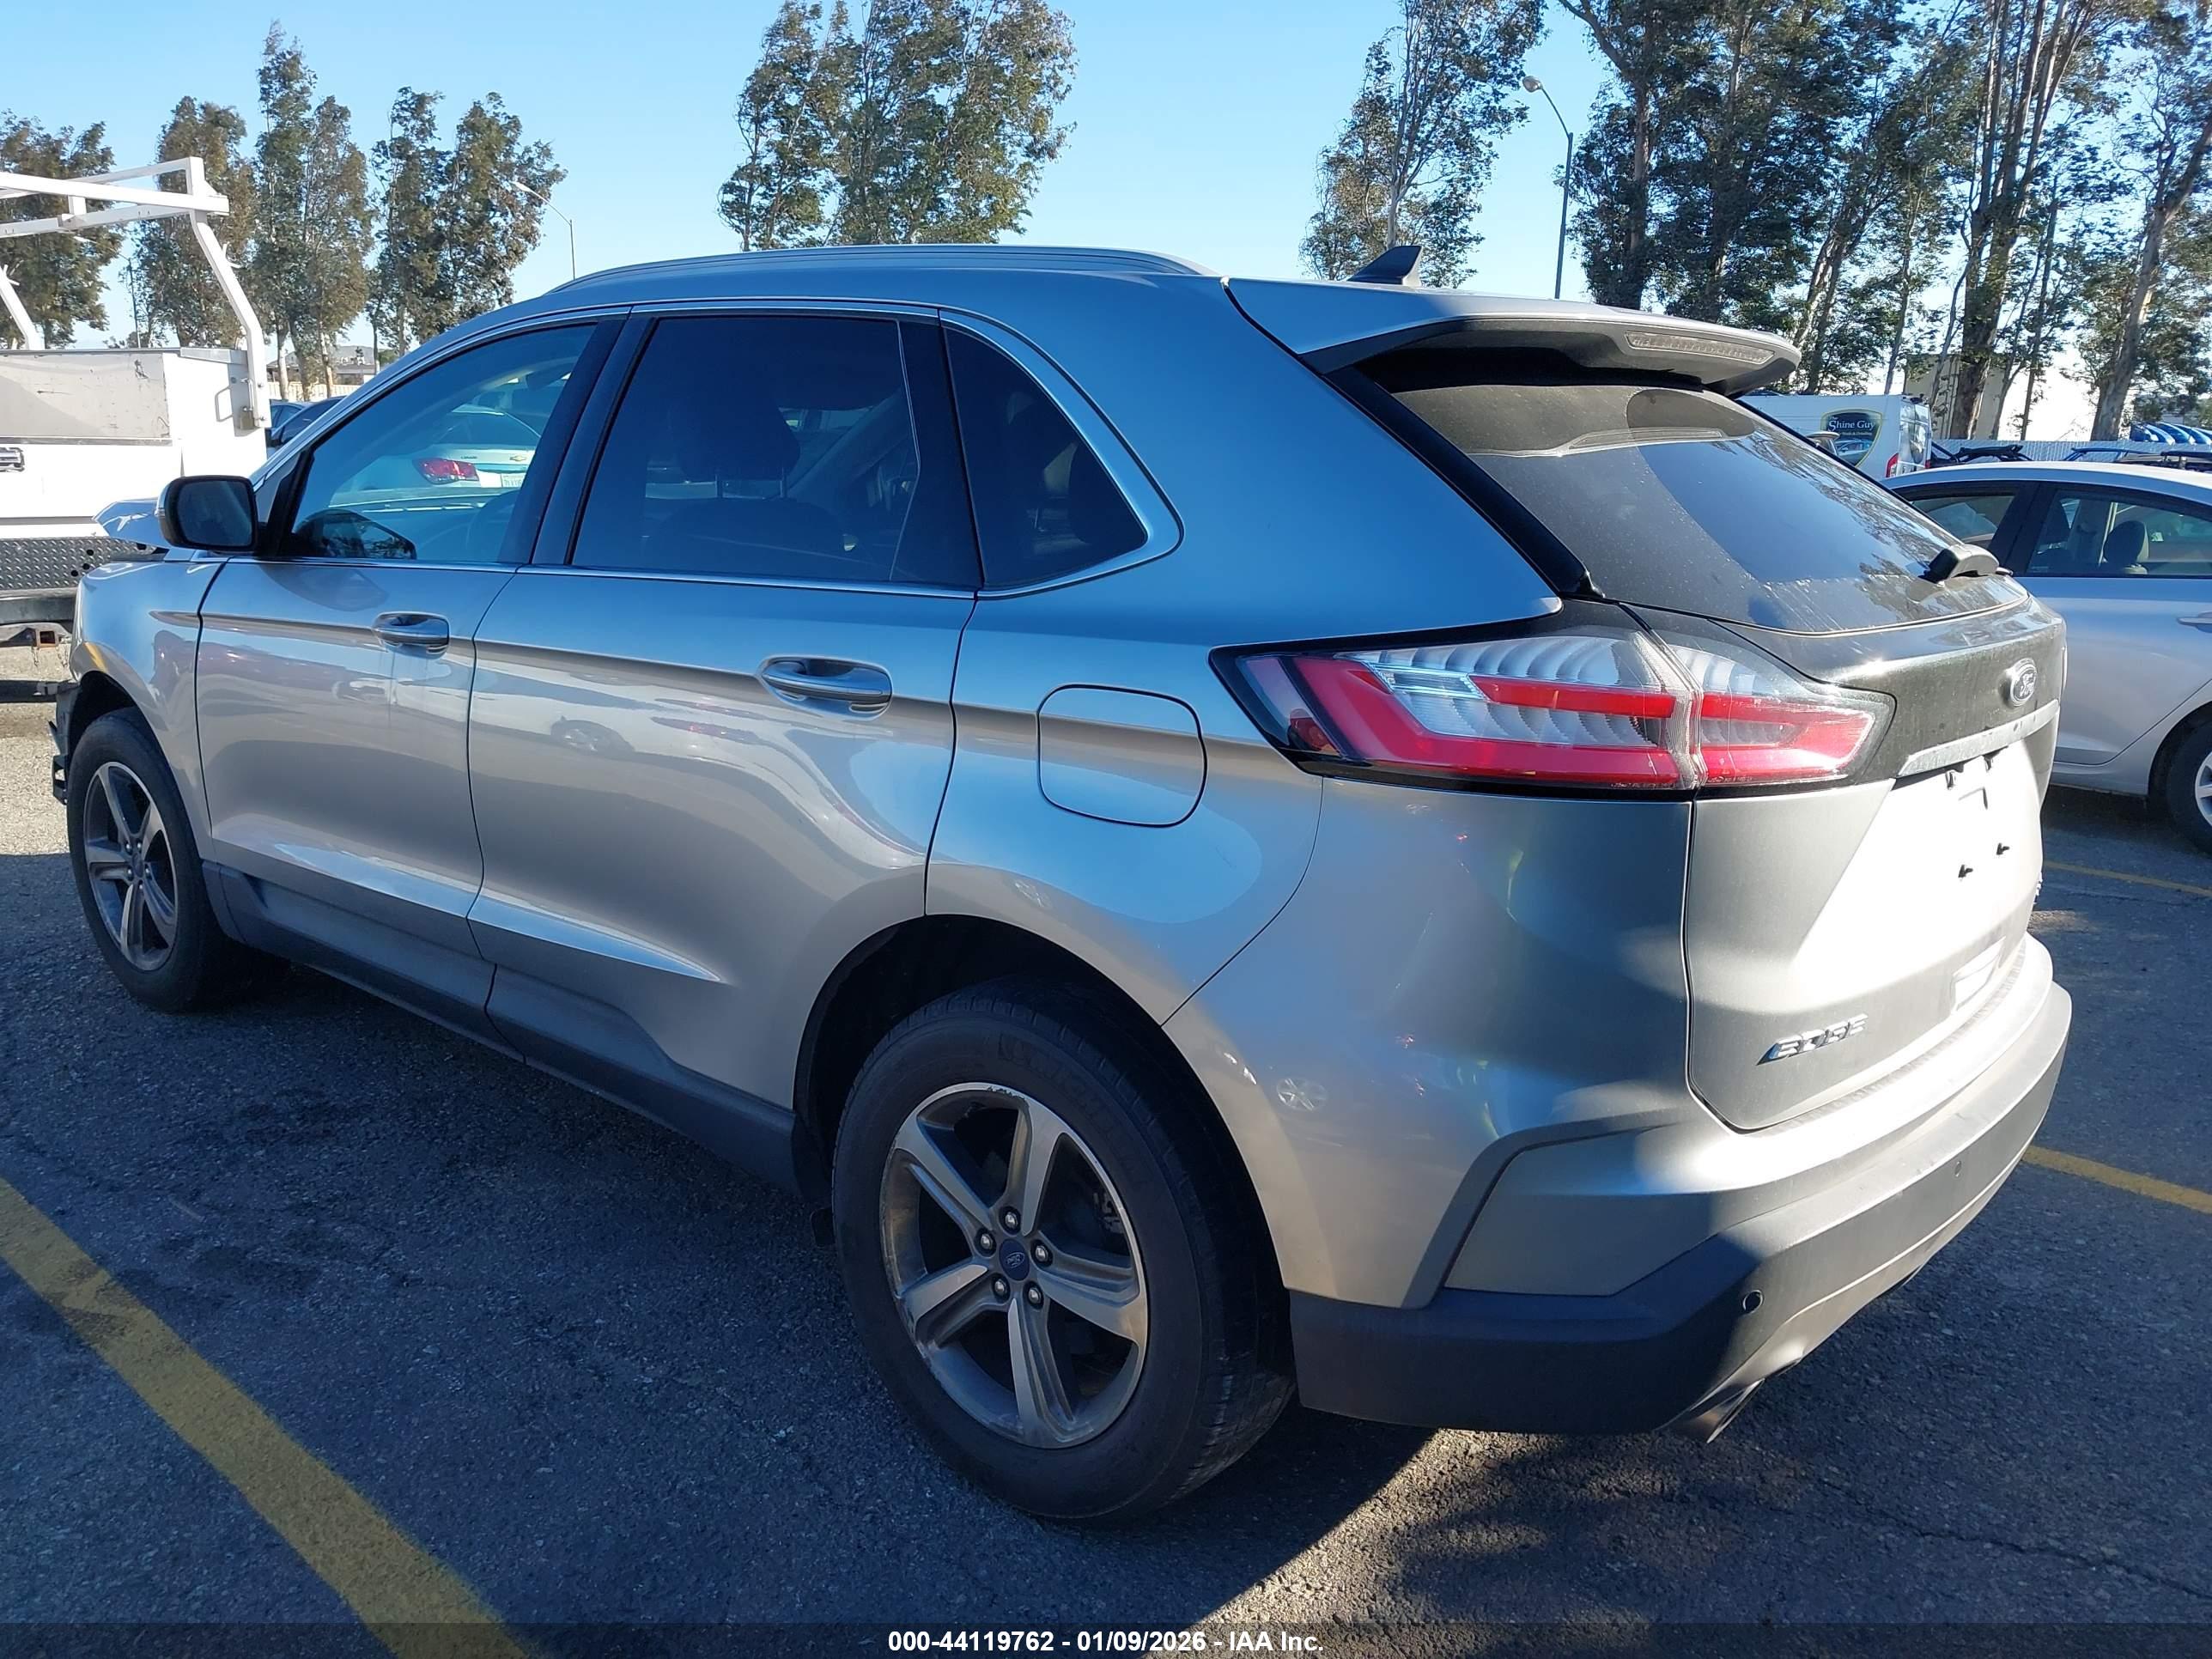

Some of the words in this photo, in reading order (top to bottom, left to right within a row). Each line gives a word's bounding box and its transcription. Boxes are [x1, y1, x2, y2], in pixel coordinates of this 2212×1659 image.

[1828, 420, 1855, 432] Shine
[1856, 420, 1875, 431] Guy
[1757, 1012, 1869, 1066] EDGE
